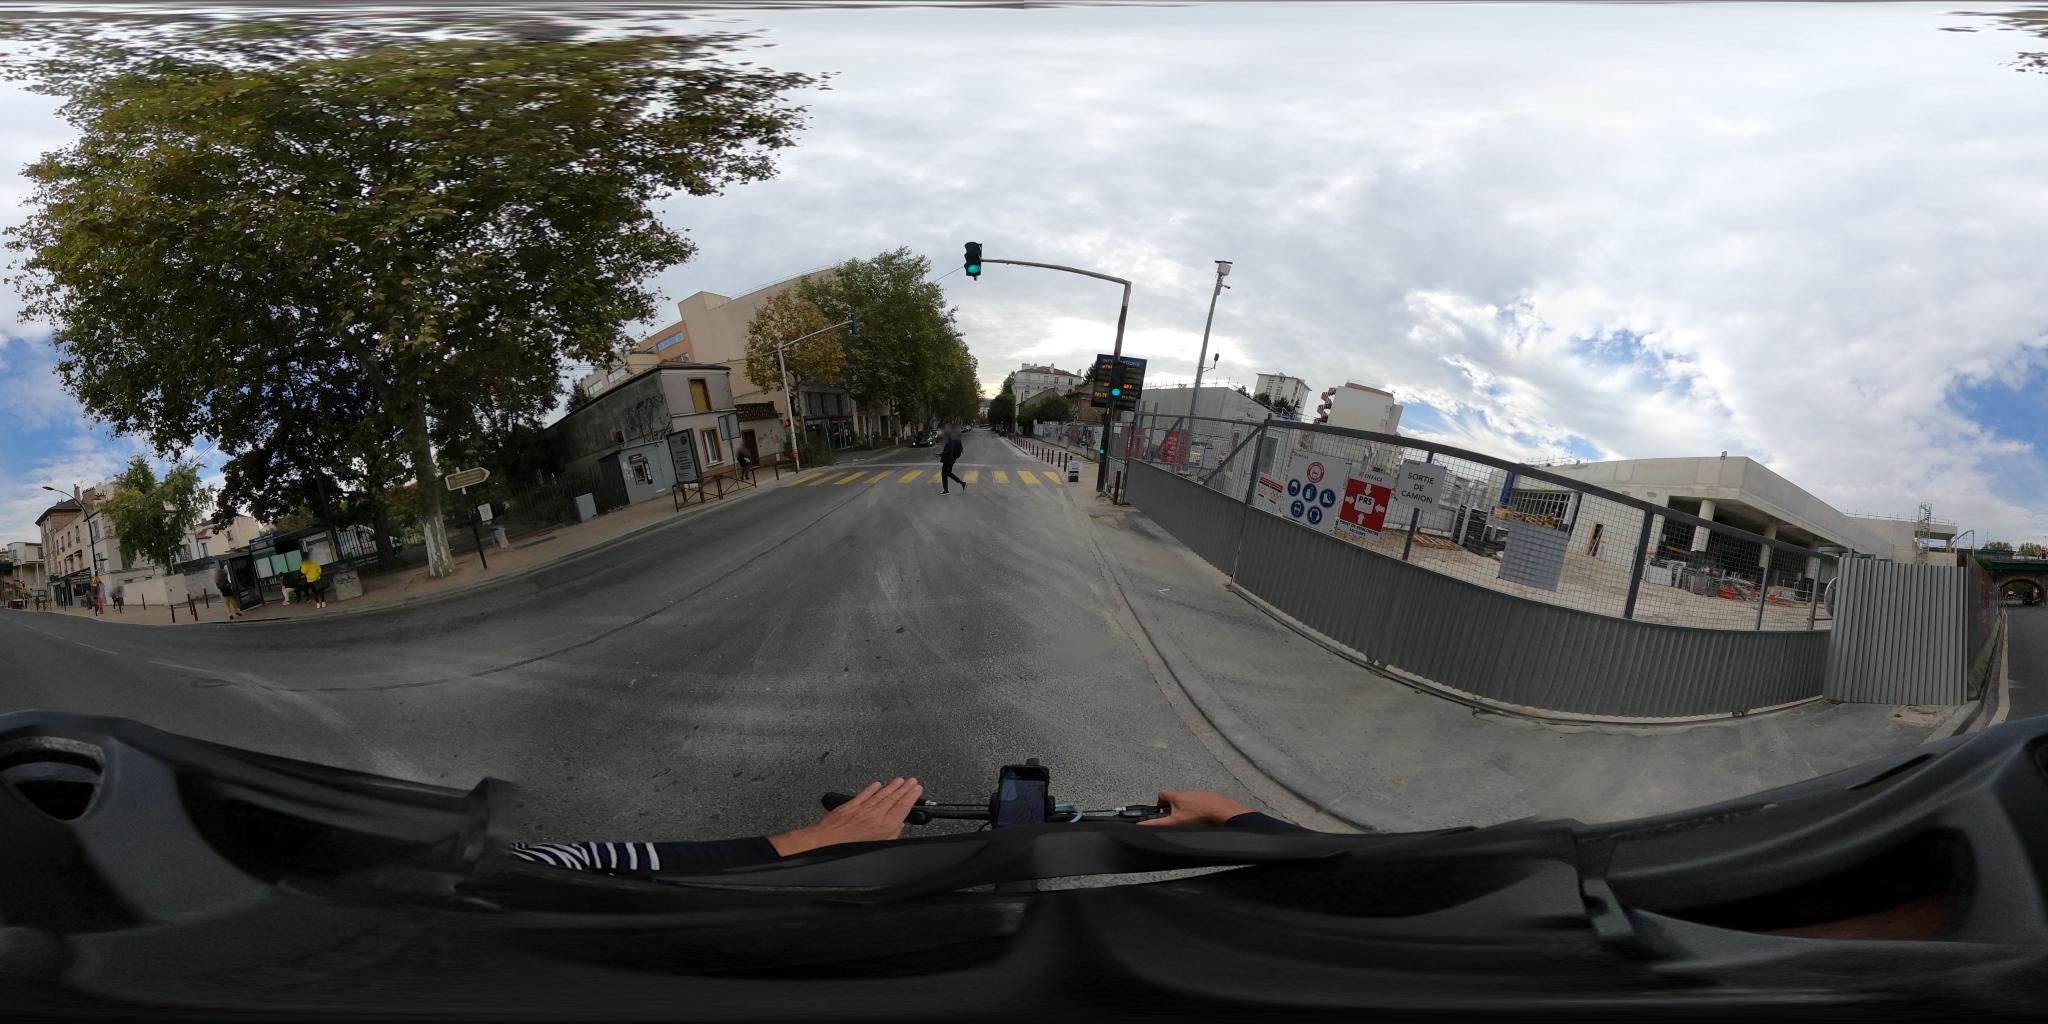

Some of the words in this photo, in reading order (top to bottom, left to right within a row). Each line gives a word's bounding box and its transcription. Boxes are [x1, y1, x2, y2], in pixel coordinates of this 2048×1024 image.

[1407, 472, 1435, 484] SORTIE
[1413, 483, 1424, 492] DE
[1358, 496, 1372, 505] PRS
[1401, 490, 1433, 504] CAMION
